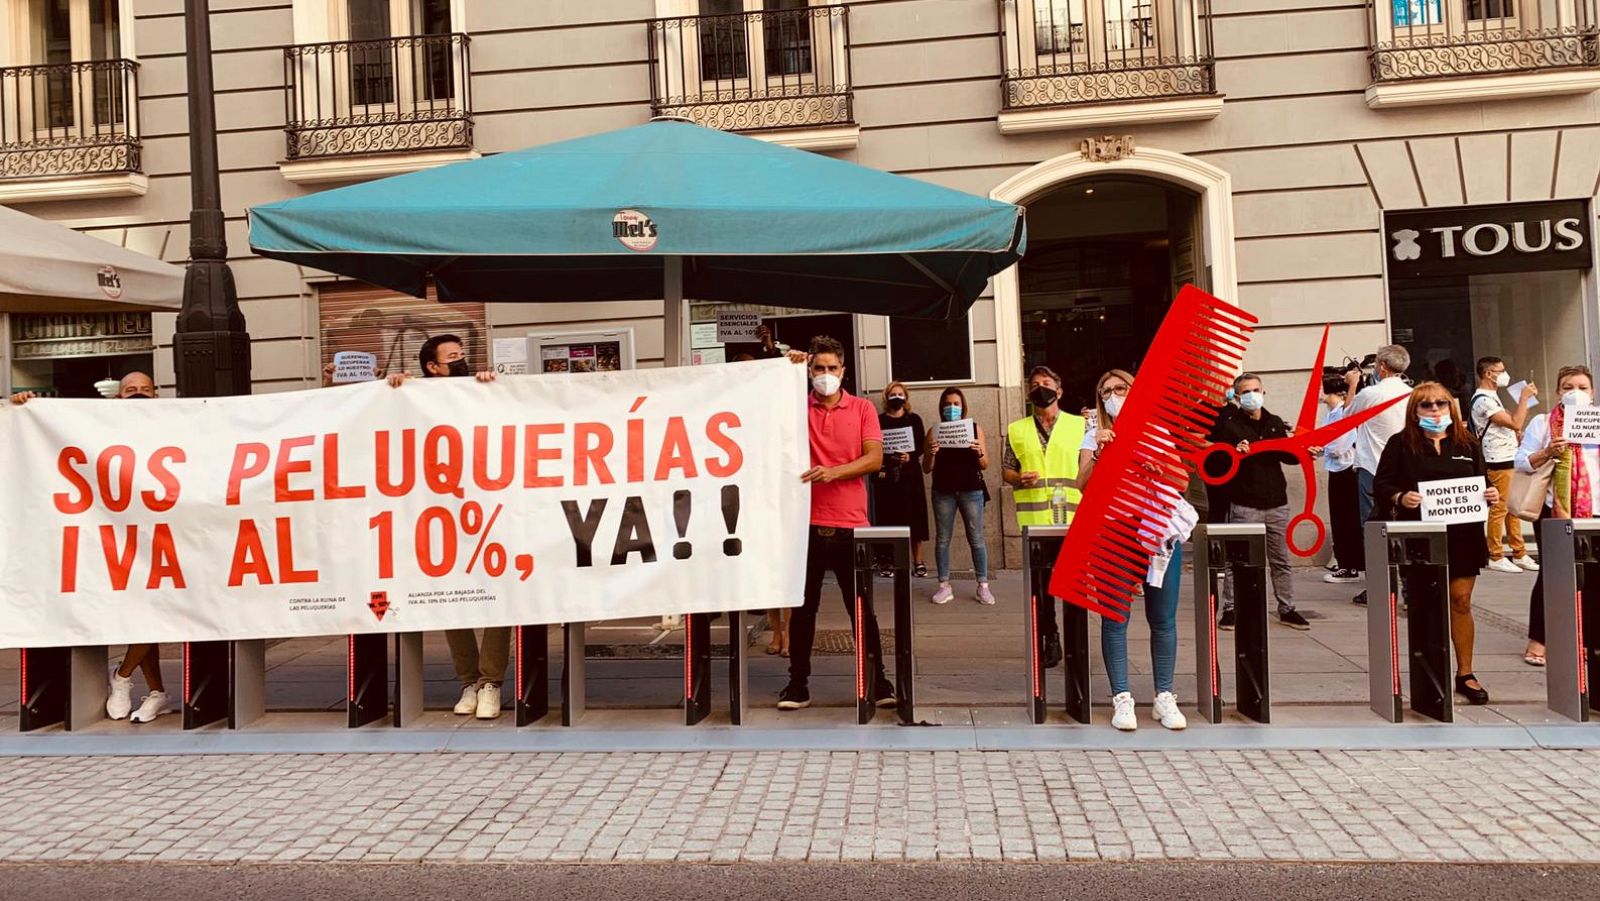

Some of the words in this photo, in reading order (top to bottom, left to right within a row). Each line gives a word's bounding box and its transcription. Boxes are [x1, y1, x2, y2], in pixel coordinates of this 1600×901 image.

[612, 219, 657, 237] Mel's
[1430, 217, 1583, 258] TOUS
[97, 272, 121, 288] Mel's
[54, 445, 187, 515] SOS
[226, 397, 743, 506] PELUQUERÍAS
[1426, 484, 1479, 496] MONTERO
[1436, 497, 1452, 506] NO
[1455, 495, 1468, 504] ES
[1428, 504, 1482, 517] MONTORO
[61, 522, 187, 593] IVA
[228, 517, 319, 588] AL
[369, 501, 535, 582] 10%,
[300, 603, 336, 611] PELUQUERÍAS
